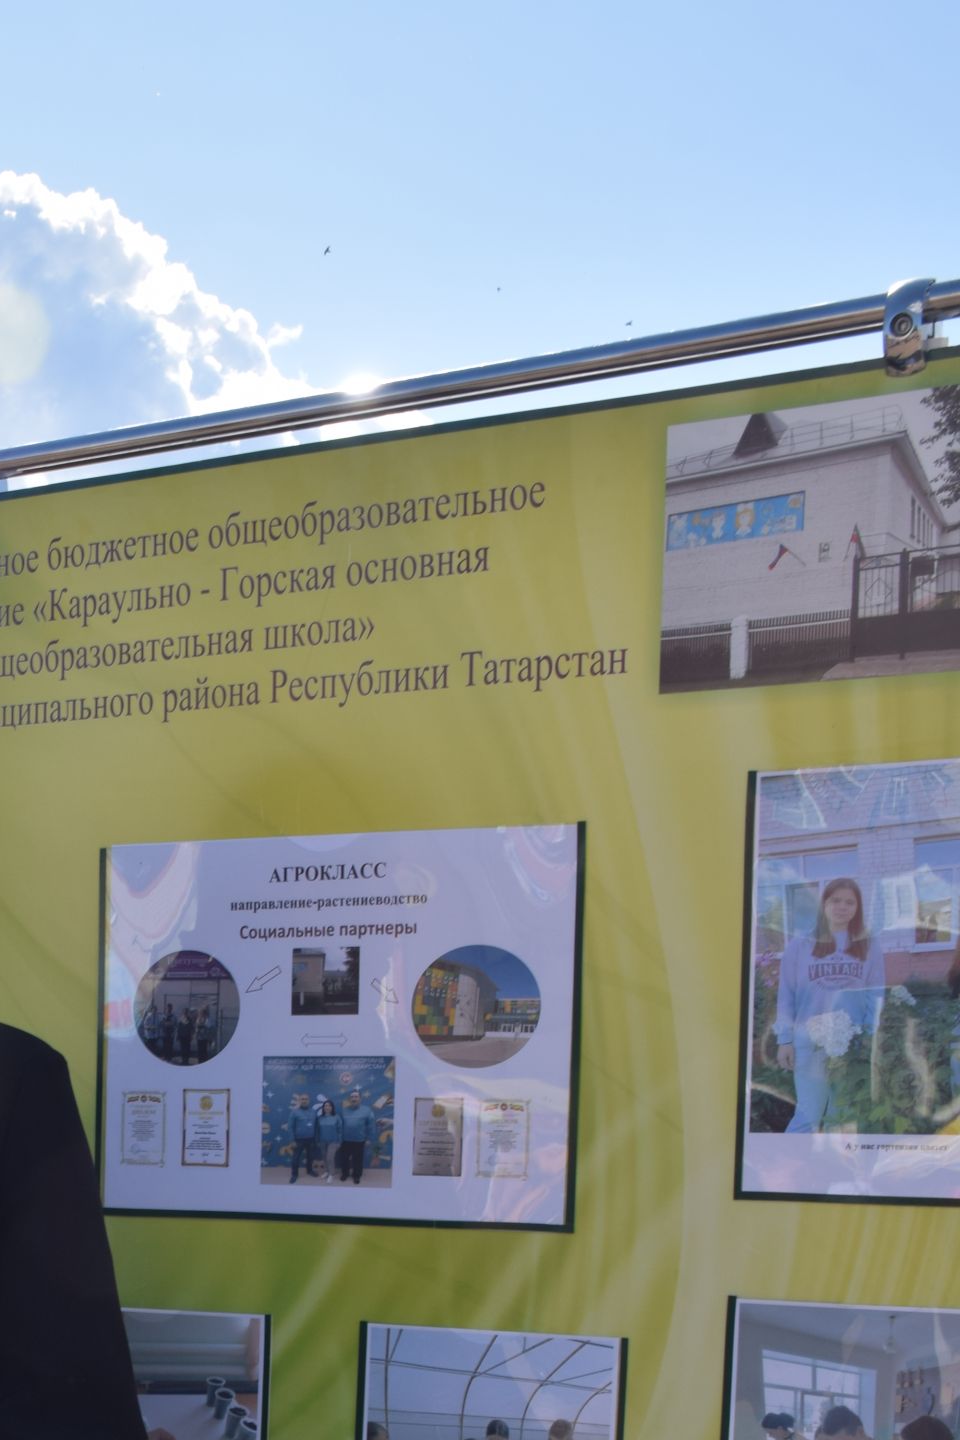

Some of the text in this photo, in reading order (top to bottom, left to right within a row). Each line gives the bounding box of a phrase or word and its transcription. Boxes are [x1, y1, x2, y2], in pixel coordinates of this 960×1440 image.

[47, 526, 199, 572] бюджетное
[208, 480, 545, 550] общеобразовательное
[33, 579, 191, 627] «Караульно
[220, 563, 336, 608] Горская
[346, 545, 490, 588] основная
[264, 616, 375, 651] школа»
[162, 677, 261, 723] района
[269, 659, 449, 708] Республики
[460, 647, 628, 692] Татарстан
[269, 862, 387, 884] АГРОКЛАСС
[230, 894, 428, 914] направление-растениеводство
[240, 921, 417, 941] Социальные партнеры
